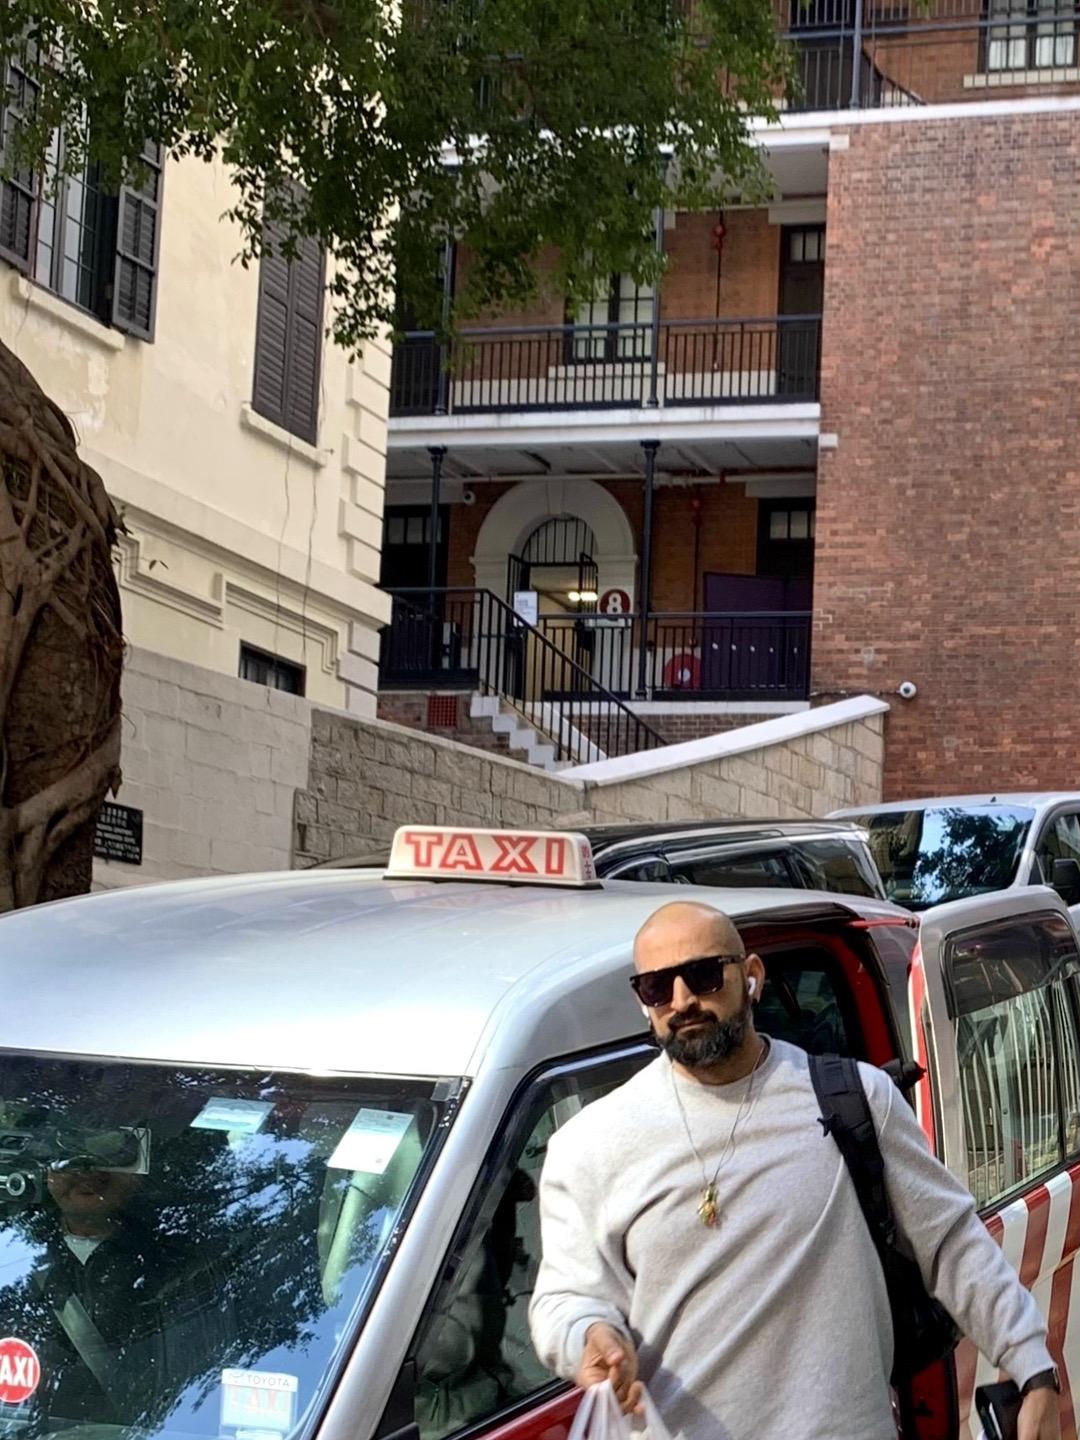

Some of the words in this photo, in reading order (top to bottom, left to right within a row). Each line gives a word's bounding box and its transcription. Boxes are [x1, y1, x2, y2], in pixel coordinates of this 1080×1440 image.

[606, 591, 623, 615] 8
[404, 832, 566, 875] TAXI
[0, 1354, 34, 1388] AXI
[247, 1374, 291, 1388] TOYOTA
